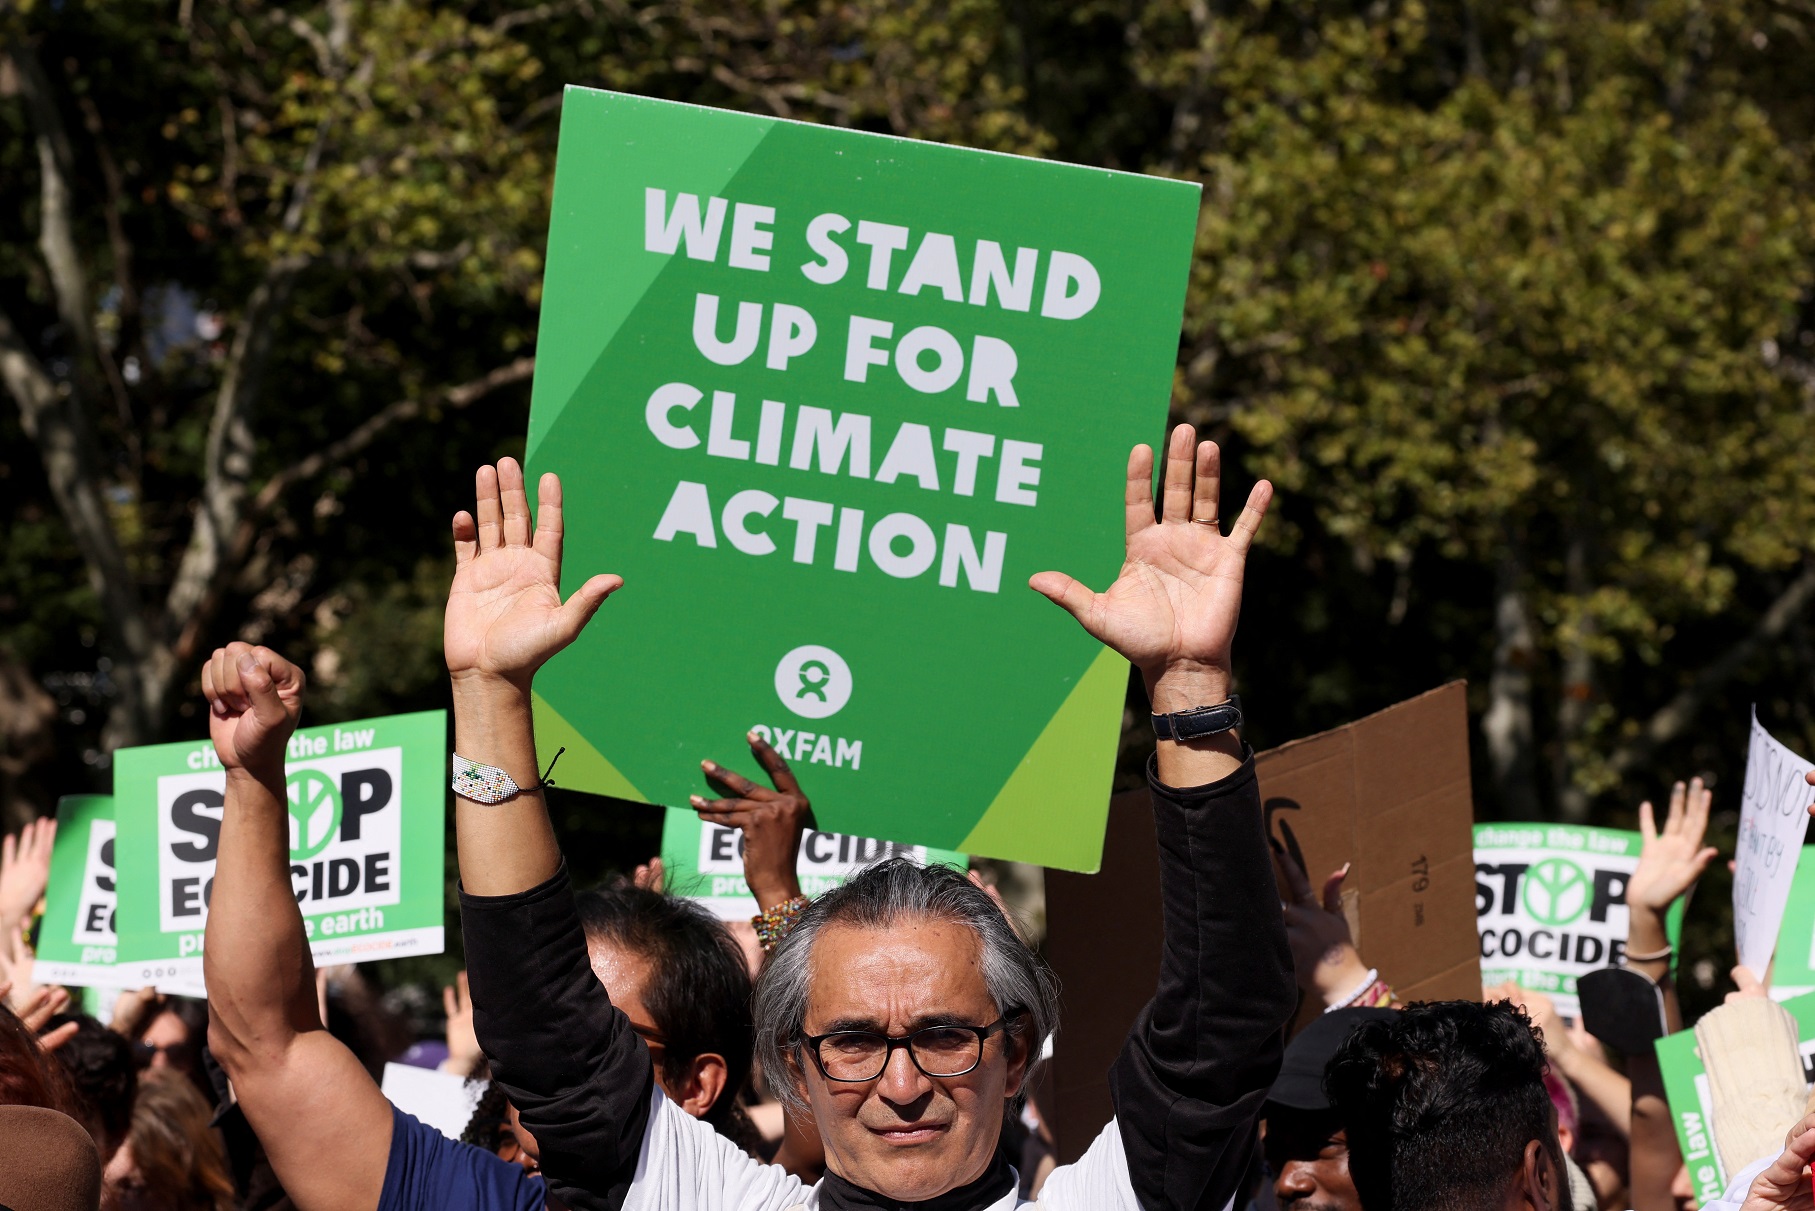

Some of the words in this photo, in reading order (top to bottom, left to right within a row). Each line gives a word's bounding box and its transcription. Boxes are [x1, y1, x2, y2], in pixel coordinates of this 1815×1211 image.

[645, 186, 776, 272] WE
[800, 212, 1101, 320] STAND
[693, 292, 817, 371] UP
[844, 314, 1019, 407] FOR
[645, 382, 1043, 506] CLIMATE
[652, 480, 1007, 593] ACTION
[288, 735, 327, 758] the
[334, 728, 375, 751] law
[1475, 828, 1543, 850] change
[1548, 828, 1584, 849] the
[1589, 831, 1629, 853] law
[1411, 853, 1430, 893] 179
[320, 905, 384, 936] earth
[1481, 928, 1628, 966] COCIDE
[1522, 969, 1561, 991] the
[1681, 1112, 1711, 1161] law
[1696, 1165, 1722, 1203] he
